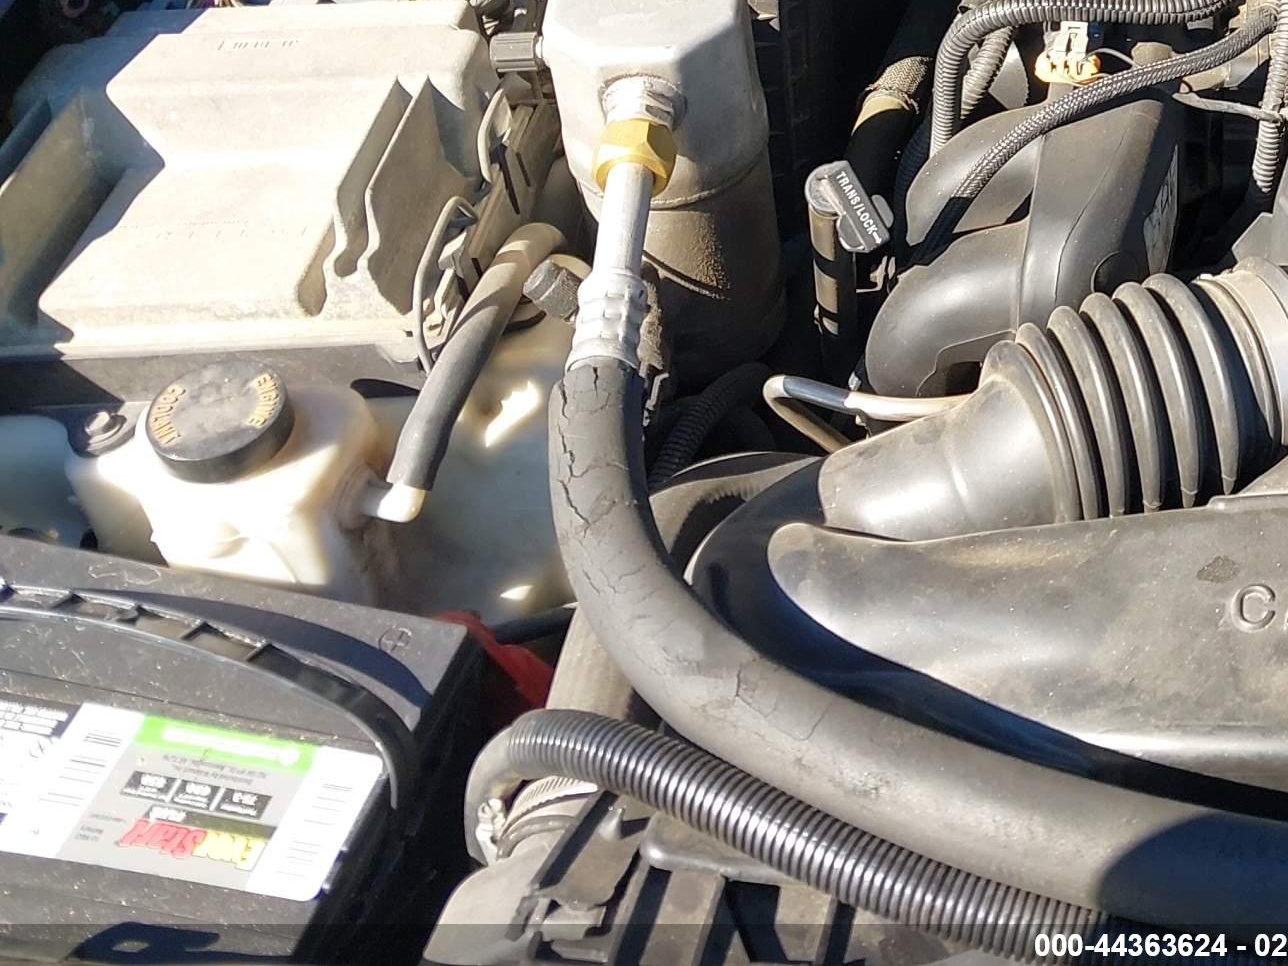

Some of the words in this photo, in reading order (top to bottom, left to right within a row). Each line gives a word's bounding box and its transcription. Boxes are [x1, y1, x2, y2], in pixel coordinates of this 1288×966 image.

[836, 170, 878, 235] TRANS/LOCK
[149, 382, 187, 447] COOLANT
[247, 373, 280, 428] ENGINE
